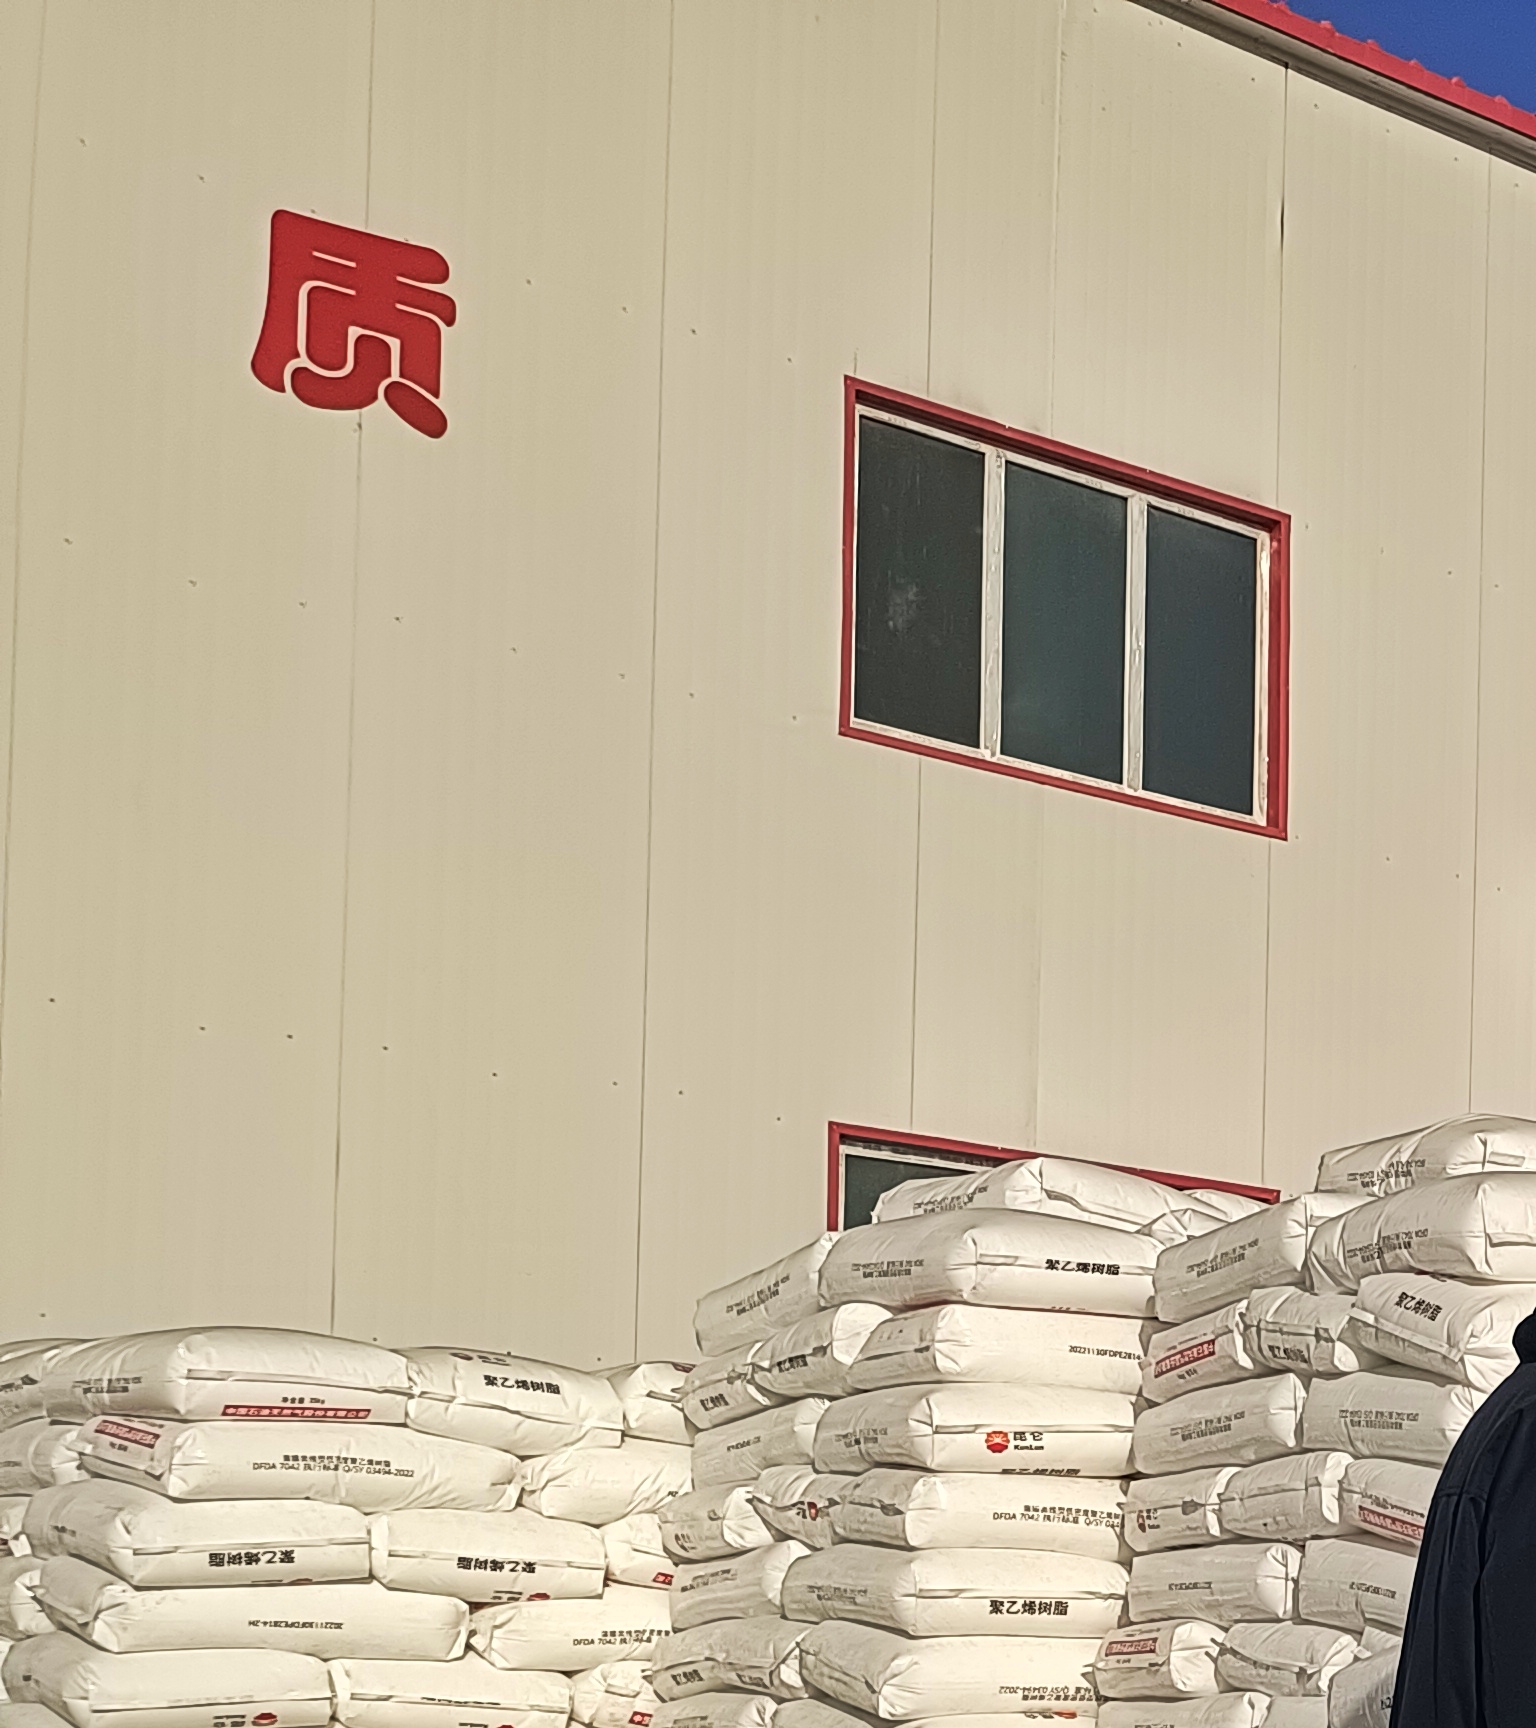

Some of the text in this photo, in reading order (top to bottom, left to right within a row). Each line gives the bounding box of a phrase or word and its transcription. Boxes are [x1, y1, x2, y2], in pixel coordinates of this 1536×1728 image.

[250, 208, 457, 440] 质
[1045, 1258, 1120, 1275] 聚乙烯树脂
[484, 1374, 561, 1394] 聚乙烯树脂
[279, 1463, 300, 1471] 7042
[342, 1465, 362, 1474] Q/SY
[365, 1466, 414, 1477] 03494-2022
[993, 1512, 1017, 1521] DFDA
[1020, 1513, 1040, 1522] 7042
[1084, 1517, 1104, 1527] Q/SY
[208, 1549, 295, 1567] 聚乙烯树脂
[989, 1600, 1069, 1616] 聚乙烯树脂
